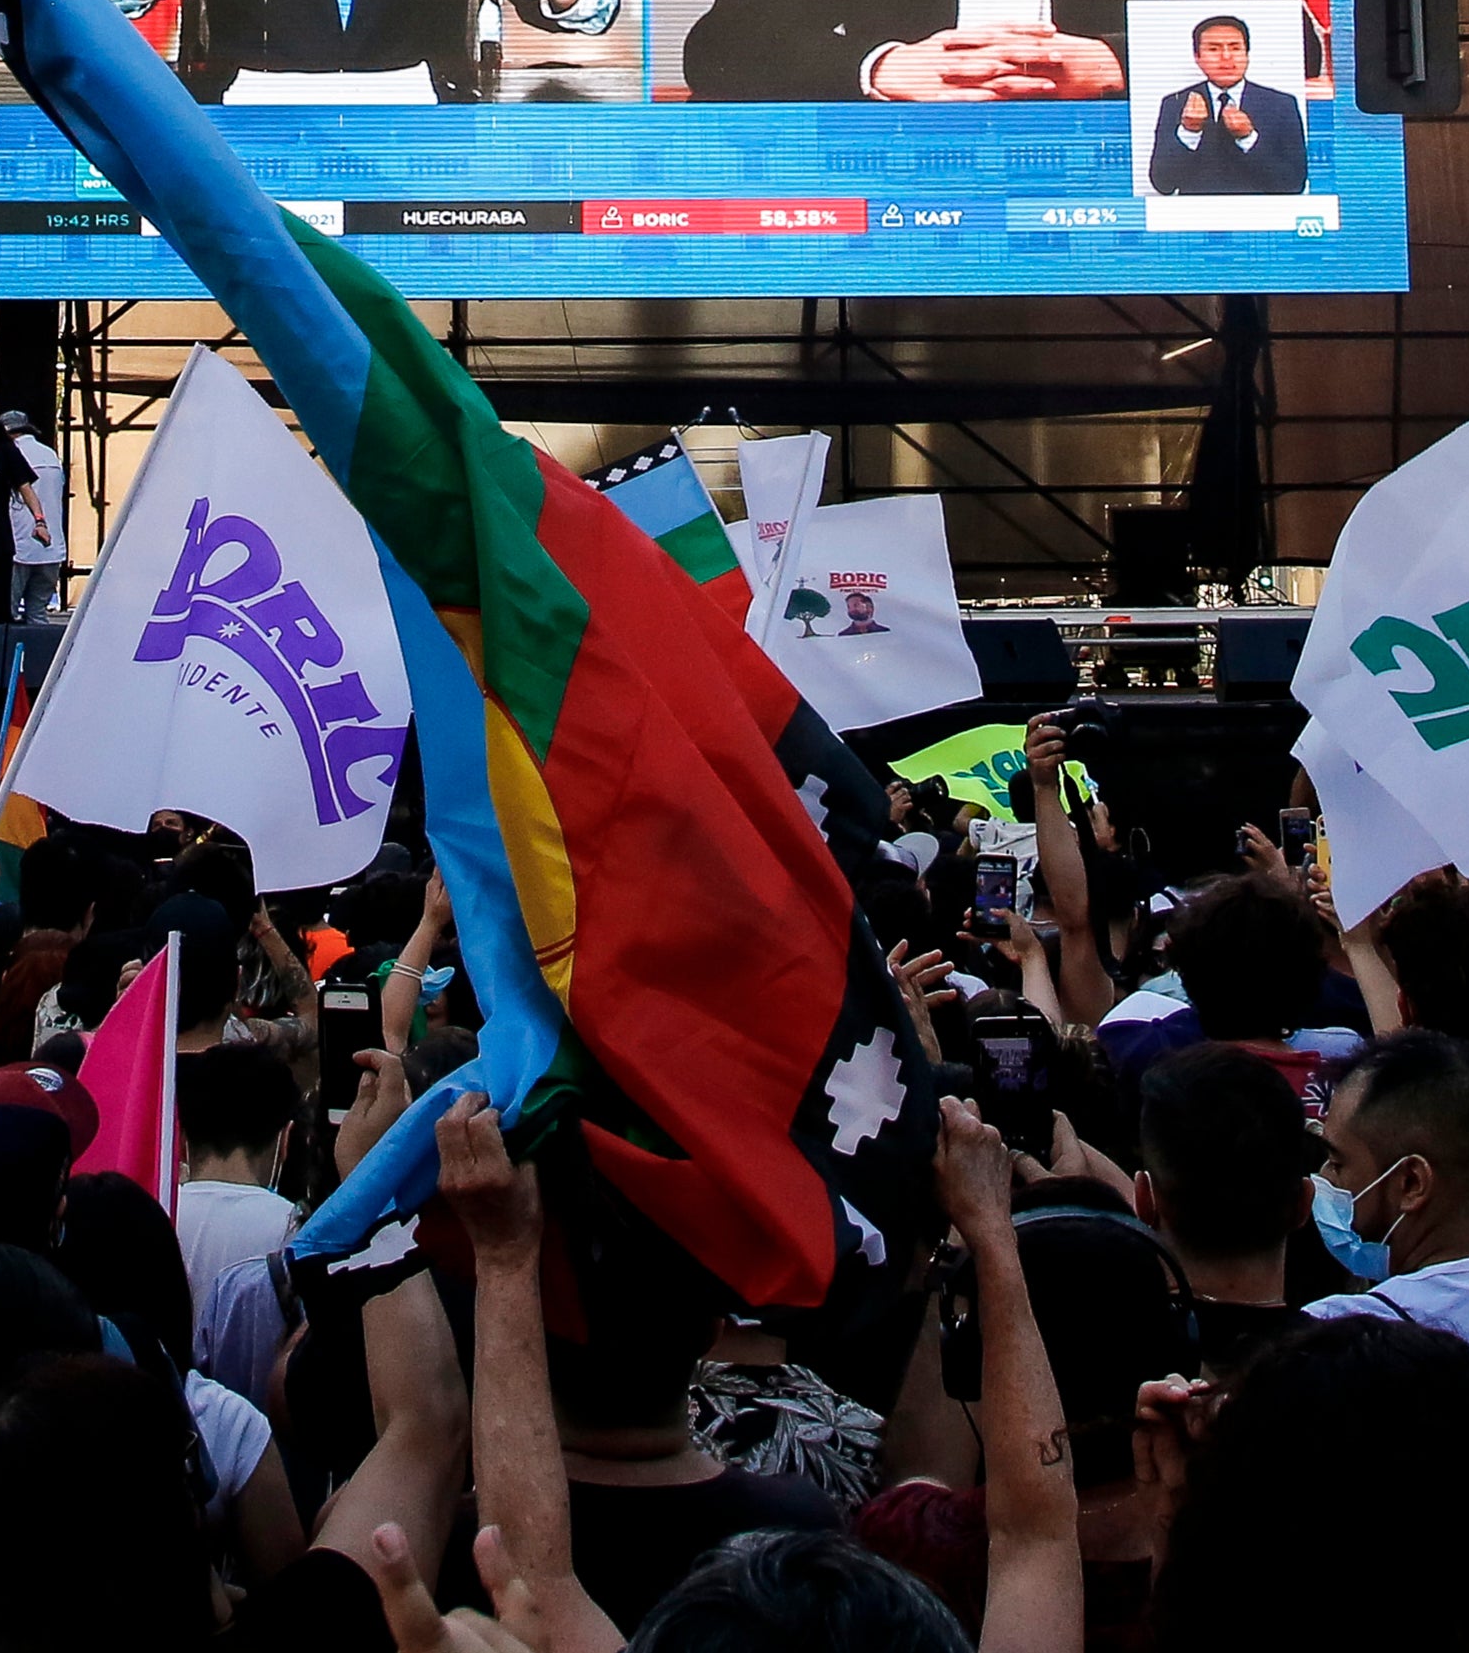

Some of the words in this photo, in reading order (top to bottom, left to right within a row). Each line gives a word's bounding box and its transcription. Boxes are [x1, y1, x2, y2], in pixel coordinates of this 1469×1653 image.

[46, 214, 90, 227] 19:42
[95, 214, 130, 227] HRS
[403, 210, 527, 226] HUECHURABA
[632, 212, 690, 227] BORIC
[759, 209, 838, 229] 58,38%
[914, 210, 963, 226] KAST
[1041, 208, 1117, 227] 41,62%
[829, 571, 888, 585] BORIC
